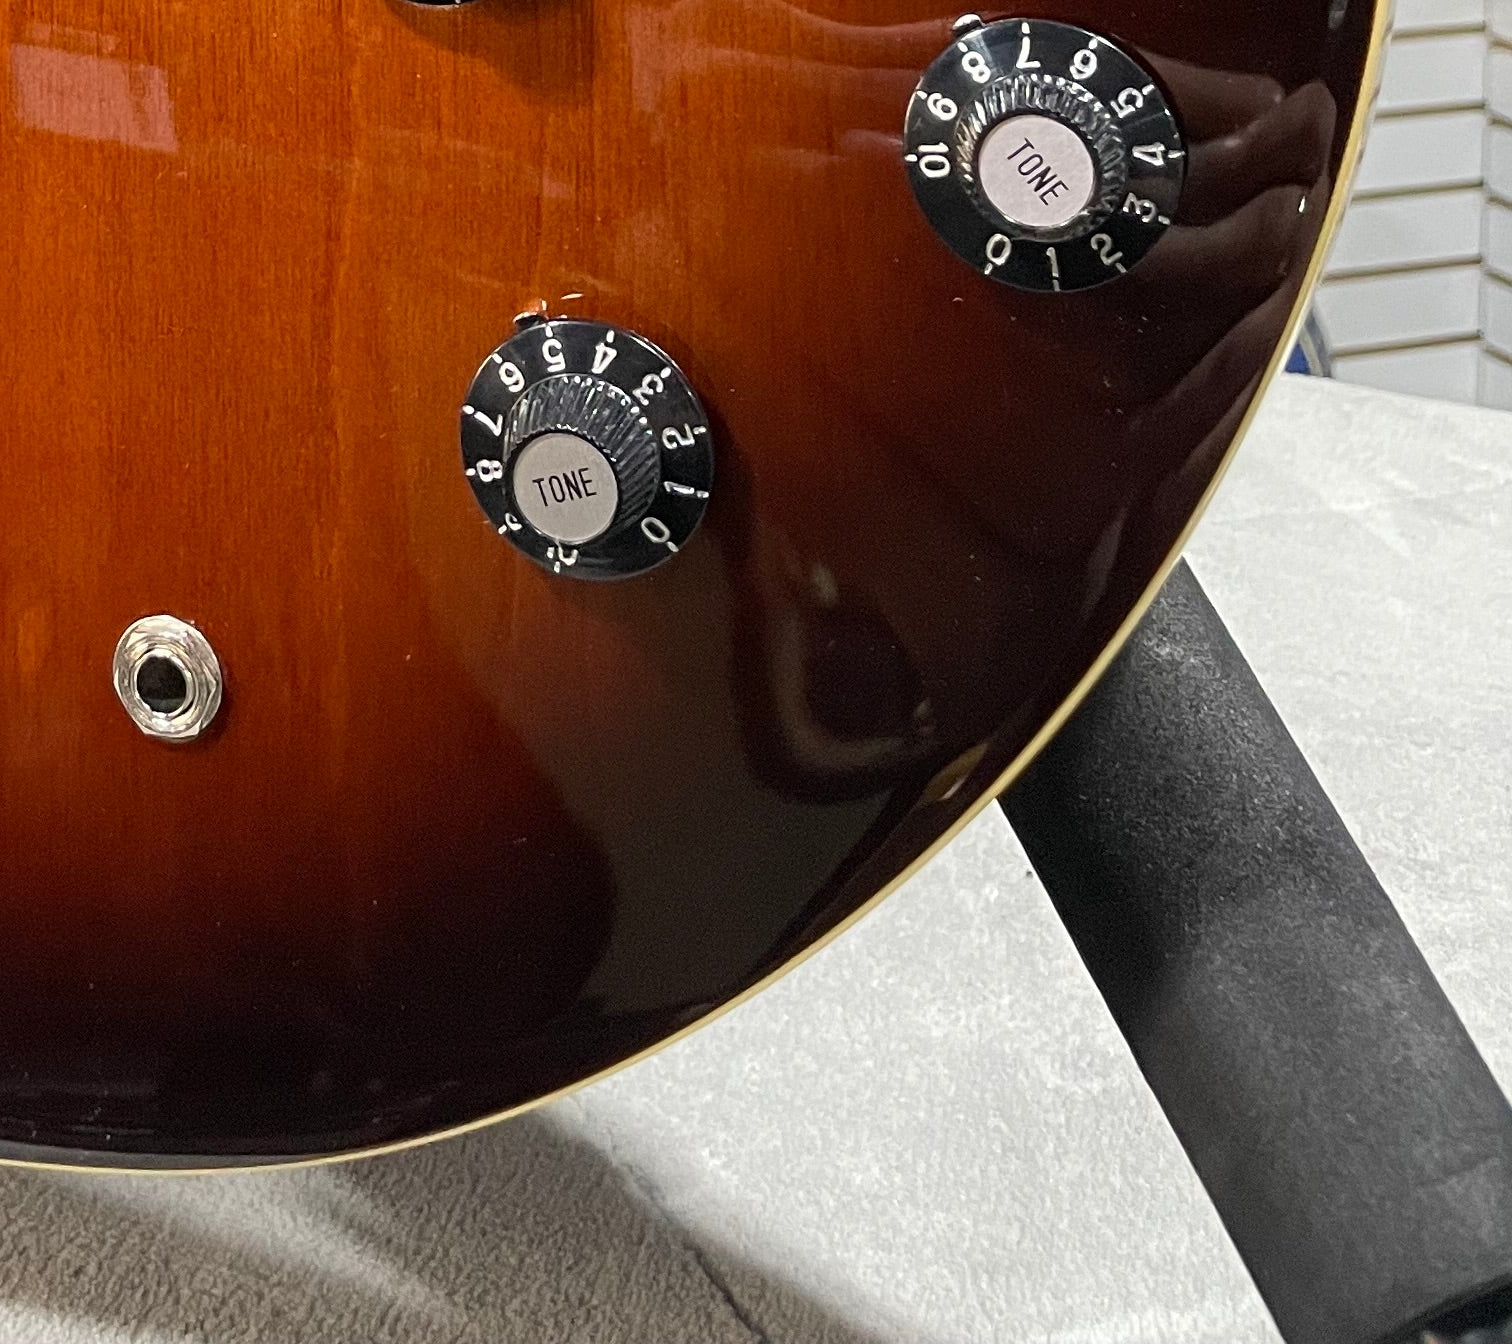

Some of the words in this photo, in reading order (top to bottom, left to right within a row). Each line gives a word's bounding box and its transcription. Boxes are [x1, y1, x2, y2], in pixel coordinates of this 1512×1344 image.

[961, 51, 990, 83] 8
[1016, 36, 1040, 68] 7
[1070, 49, 1097, 80] 6
[927, 92, 958, 121] 9
[1110, 88, 1143, 118] 5
[918, 142, 951, 178] 10
[1132, 142, 1166, 166] 4
[1007, 138, 1069, 205] TONE
[1123, 192, 1156, 222] 3
[986, 233, 1012, 265] 0
[1046, 246, 1059, 278] 1
[1090, 233, 1122, 265] 2
[541, 338, 566, 372] 5
[592, 342, 617, 374] 4
[498, 361, 525, 393] 6
[633, 373, 664, 406] 3
[474, 411, 503, 437] 7
[662, 423, 695, 450] 2
[476, 459, 502, 482] 8
[532, 468, 597, 506] TONE
[664, 481, 694, 494] 1
[641, 516, 670, 543] 0
